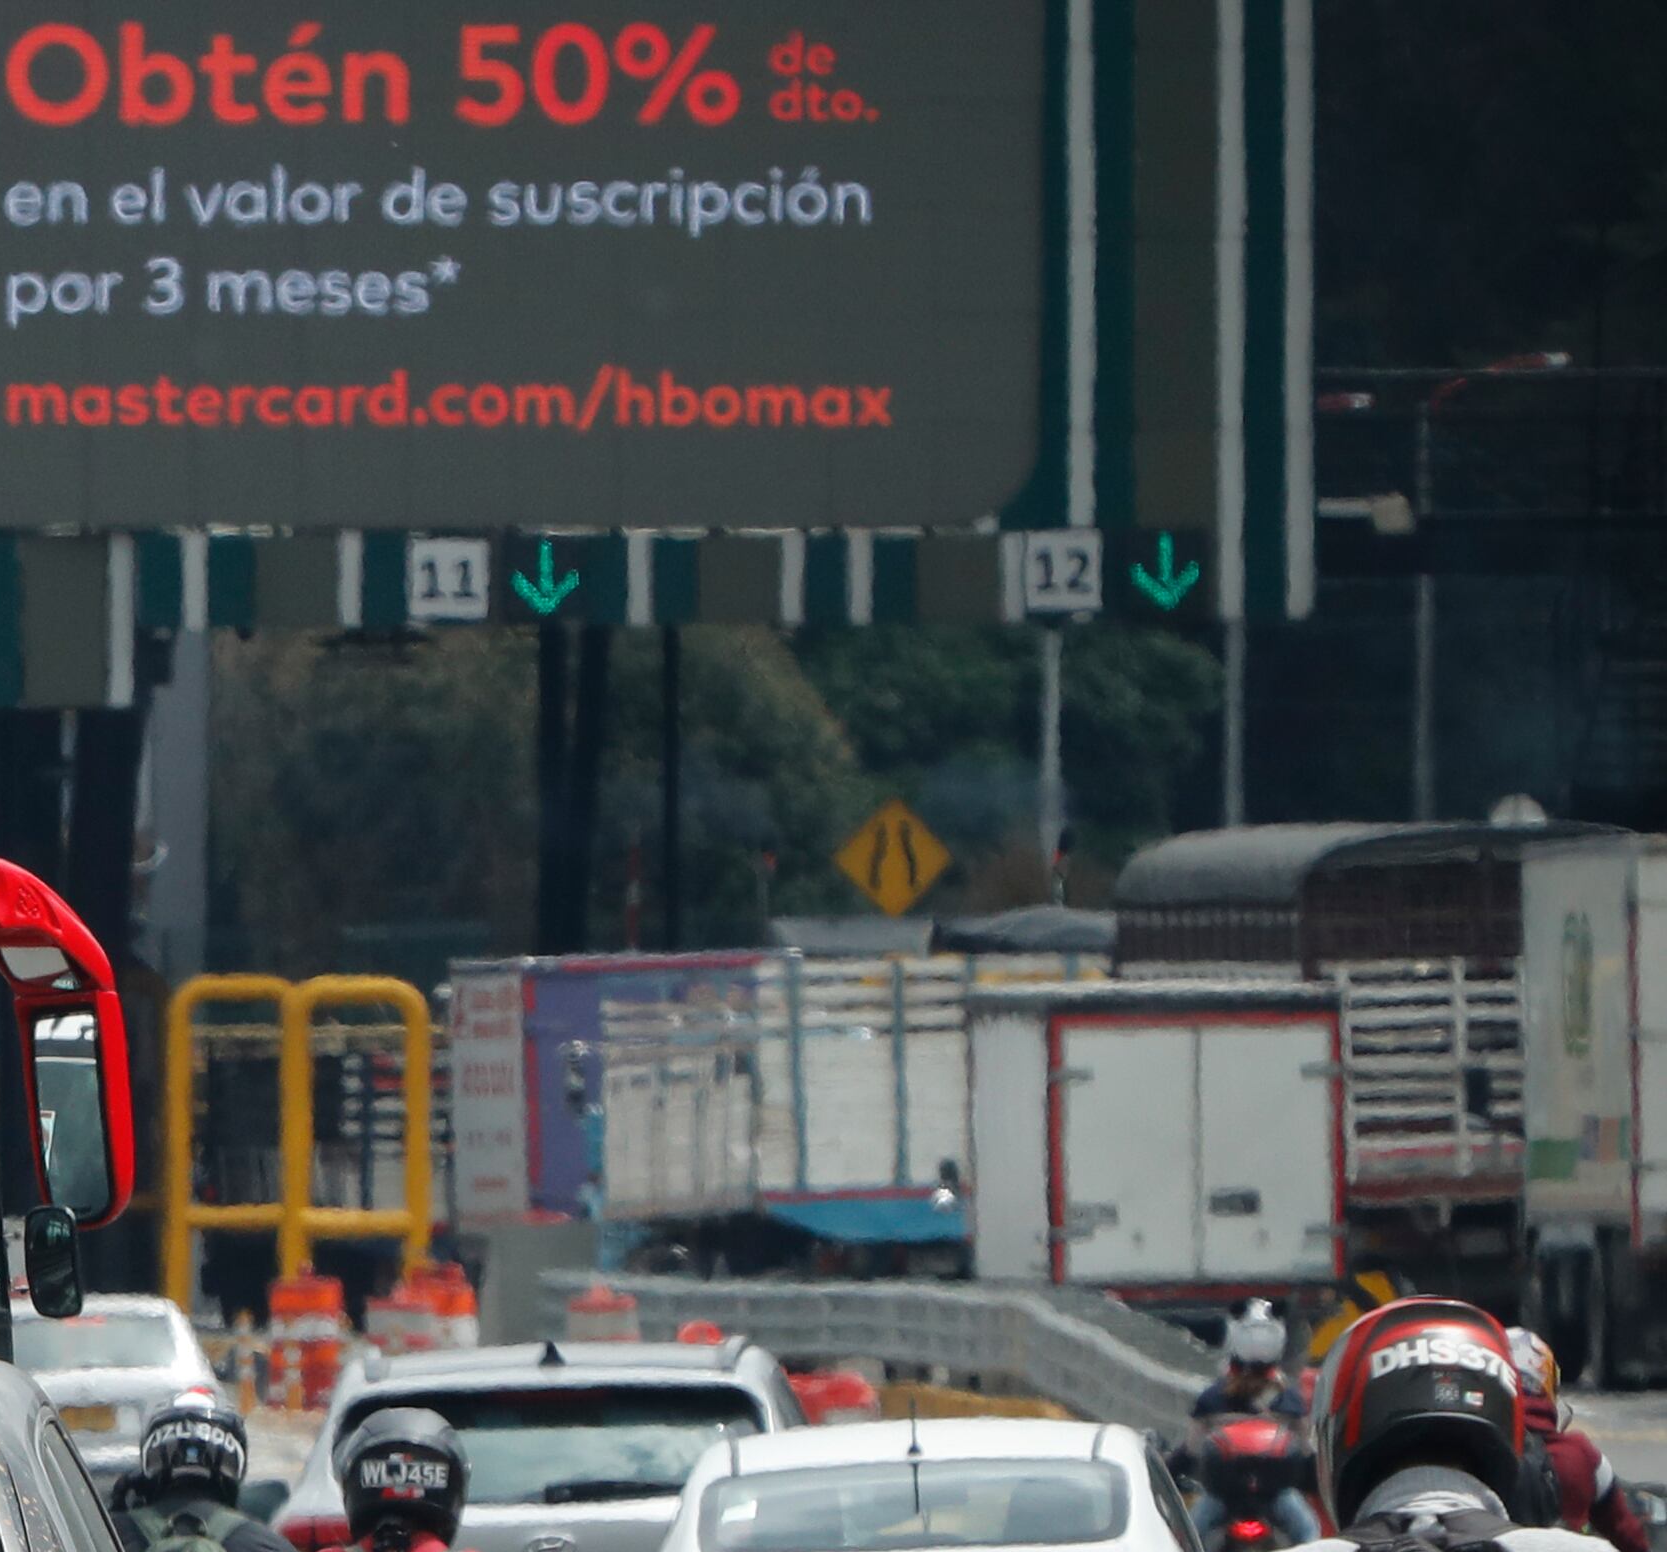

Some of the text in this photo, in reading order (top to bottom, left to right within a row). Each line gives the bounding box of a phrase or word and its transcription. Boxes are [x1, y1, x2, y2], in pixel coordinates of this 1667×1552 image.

[5, 20, 741, 126] Obtén 50%
[769, 30, 835, 76] de
[769, 78, 879, 123] dto.
[3, 164, 874, 238] en el valor de suscripción
[5, 270, 123, 329] por
[144, 256, 186, 316] 3
[4, 365, 894, 430] mastercard.com/hbomax
[419, 557, 476, 602] 11
[1034, 549, 1093, 594] 12
[1370, 1338, 1518, 1397] DHS37E
[360, 1459, 449, 1488] WLJ45E
